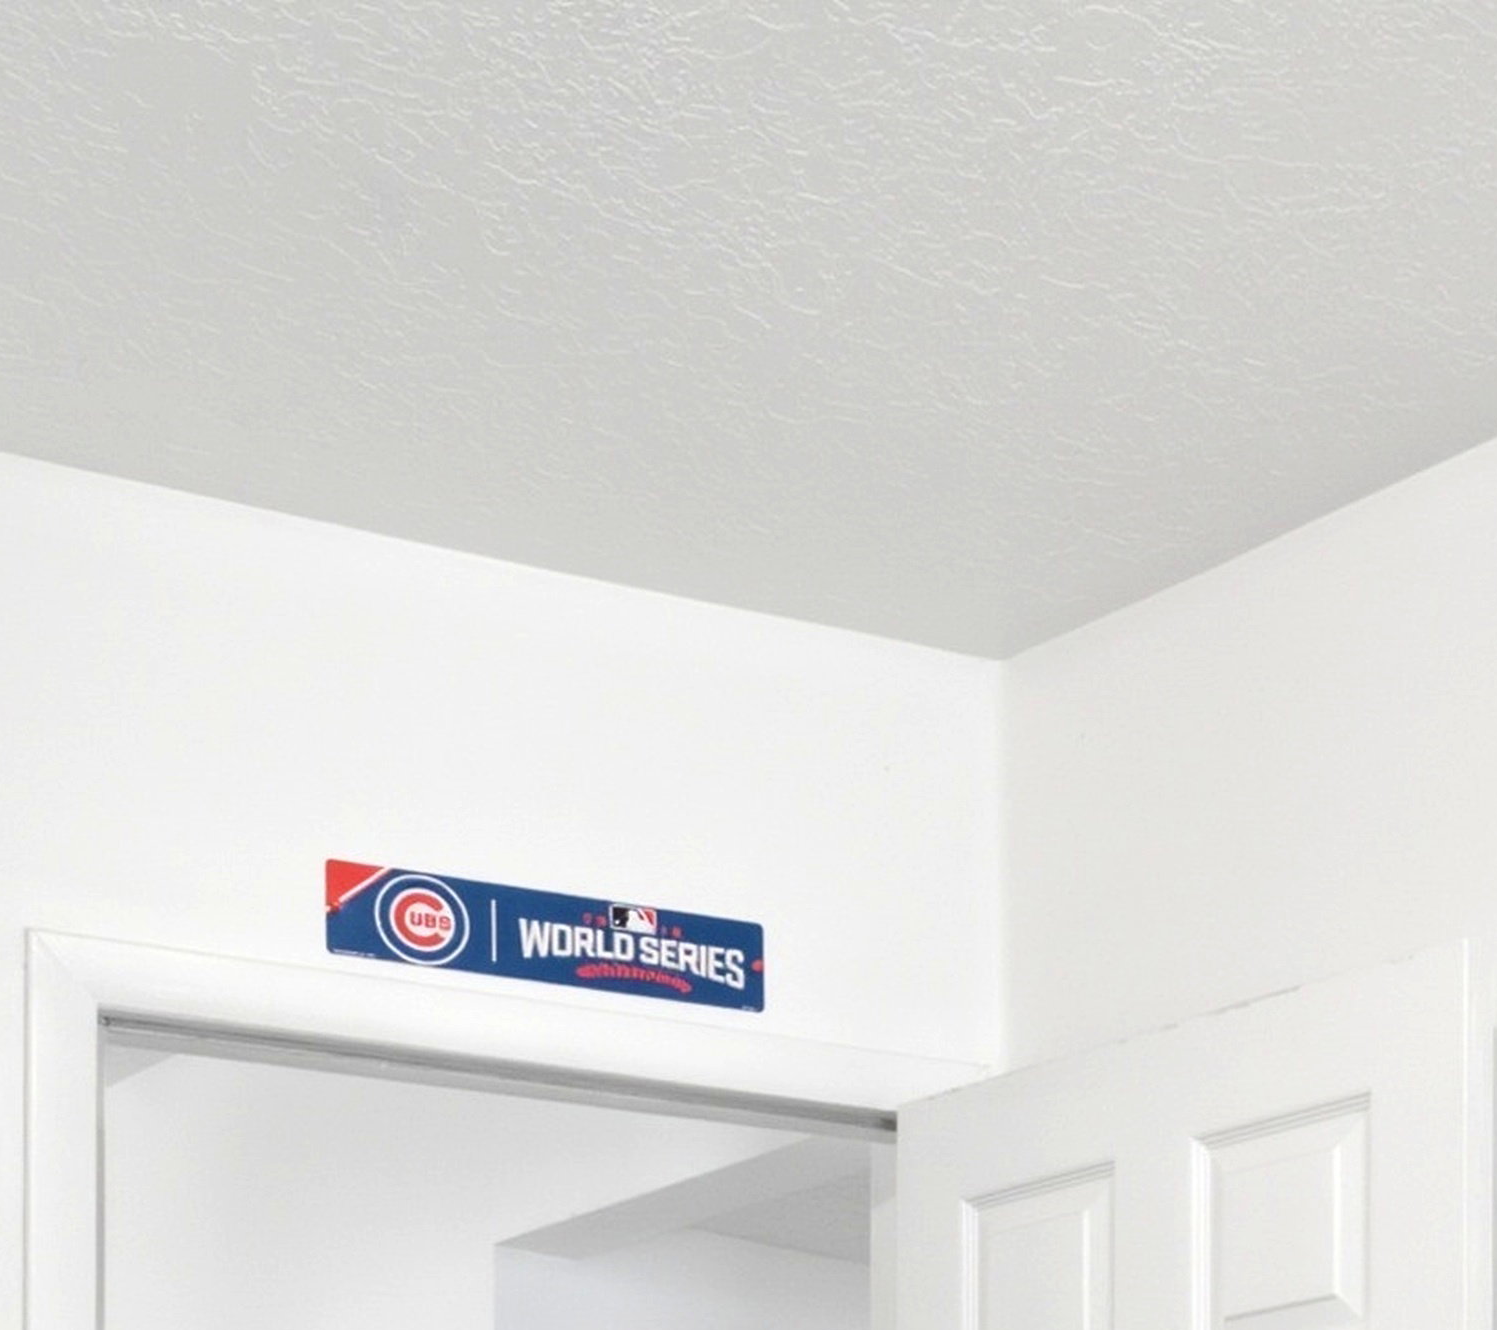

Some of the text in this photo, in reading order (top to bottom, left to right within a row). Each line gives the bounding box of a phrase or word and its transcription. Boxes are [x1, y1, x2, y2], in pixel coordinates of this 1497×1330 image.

[393, 891, 452, 948] CUBS
[518, 917, 634, 963] WORLD
[639, 935, 746, 990] SERIES
